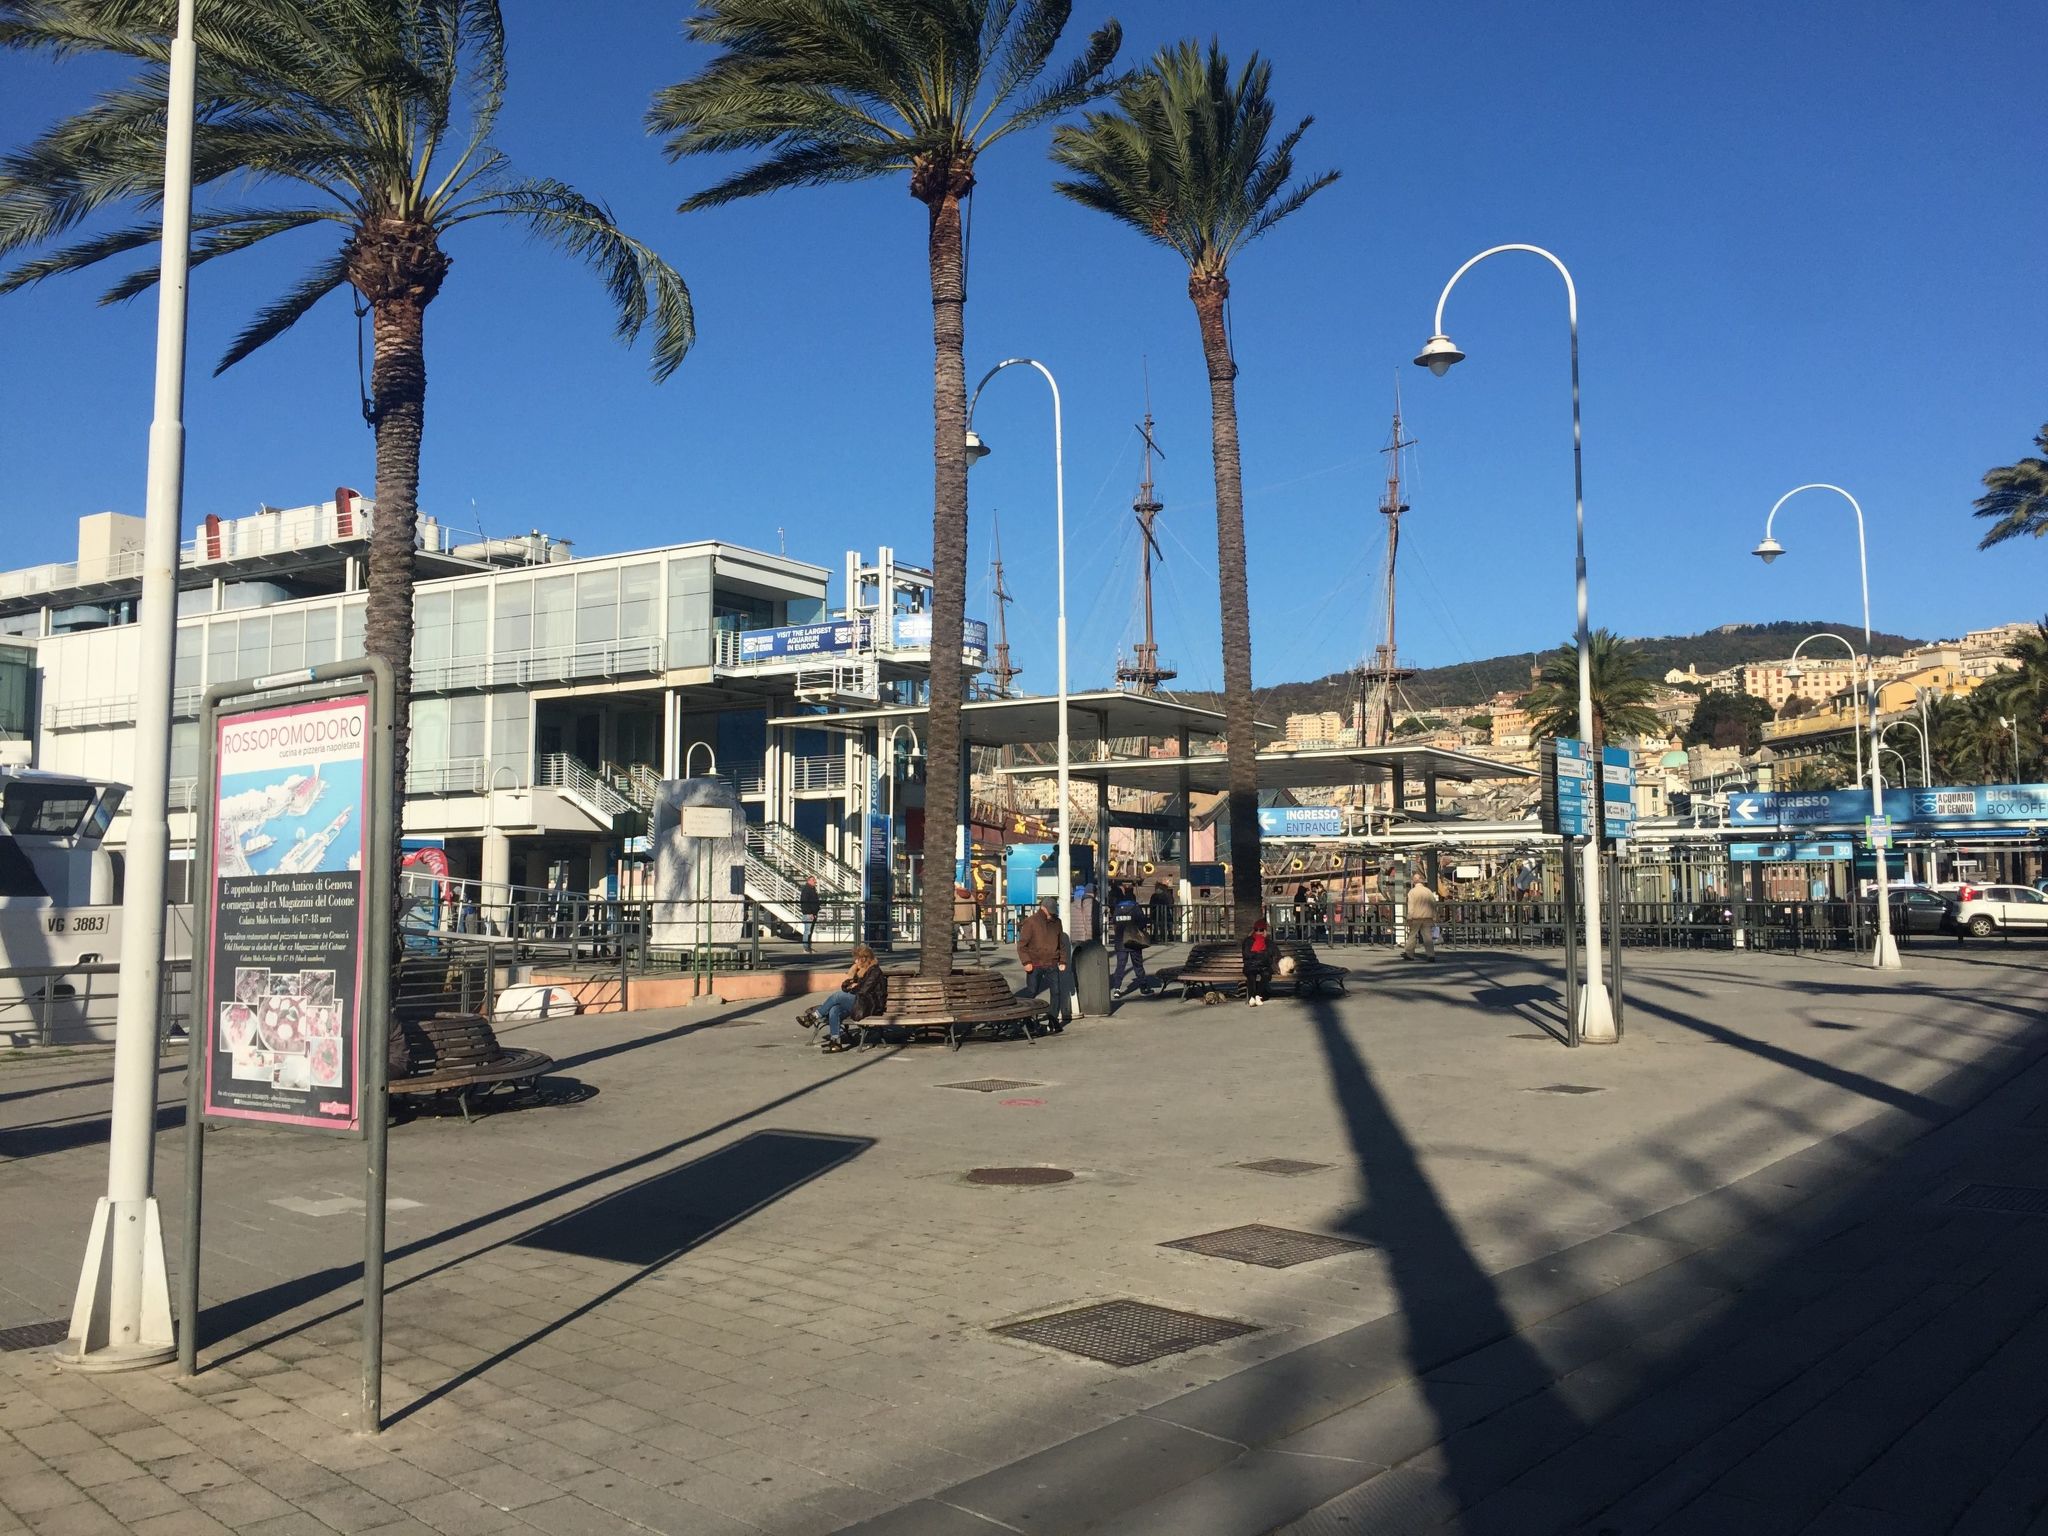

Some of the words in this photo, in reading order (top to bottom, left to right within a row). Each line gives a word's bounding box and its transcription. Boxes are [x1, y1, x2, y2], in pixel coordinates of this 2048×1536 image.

[776, 629, 790, 638] VISIT
[792, 628, 804, 637] THE
[805, 626, 832, 636] LARGEST
[788, 635, 820, 644] AQUARIUM
[787, 644, 794, 652] IN
[794, 642, 820, 651] EUROPE.
[224, 716, 362, 754] ROSSOPOMODORO
[279, 746, 298, 758] cucina
[298, 748, 302, 757] e
[303, 745, 326, 758] pizzeria
[326, 740, 360, 755] napoletana
[1764, 795, 1830, 808] INGRESSO
[1938, 793, 1973, 803] ACQUARIO
[1765, 808, 1830, 820] ENTRANCE
[1938, 804, 1946, 814] DI
[1947, 803, 1974, 814] GENOVA
[1987, 804, 2014, 814] BOX
[1286, 809, 1338, 820] INGRESSO
[1286, 822, 1339, 832] ENTRANCE
[1774, 847, 1787, 856] 00
[1839, 846, 1850, 855] 30
[231, 882, 262, 898] approdato
[263, 881, 269, 893] al
[271, 881, 290, 893] Porto
[291, 879, 314, 891] Antico
[315, 878, 322, 890] di
[324, 877, 352, 890] Genova
[221, 902, 225, 910] e
[226, 898, 254, 913] ormeggia
[256, 896, 268, 912] agli
[269, 900, 276, 908] ex
[279, 896, 313, 912] Magazzini
[315, 894, 326, 907] del
[328, 894, 354, 907] Cotone
[270, 914, 290, 924] Vecchio
[292, 913, 318, 924] 16-17-18
[320, 914, 332, 923] neri
[48, 918, 64, 932] VG
[73, 917, 104, 931] 3883
